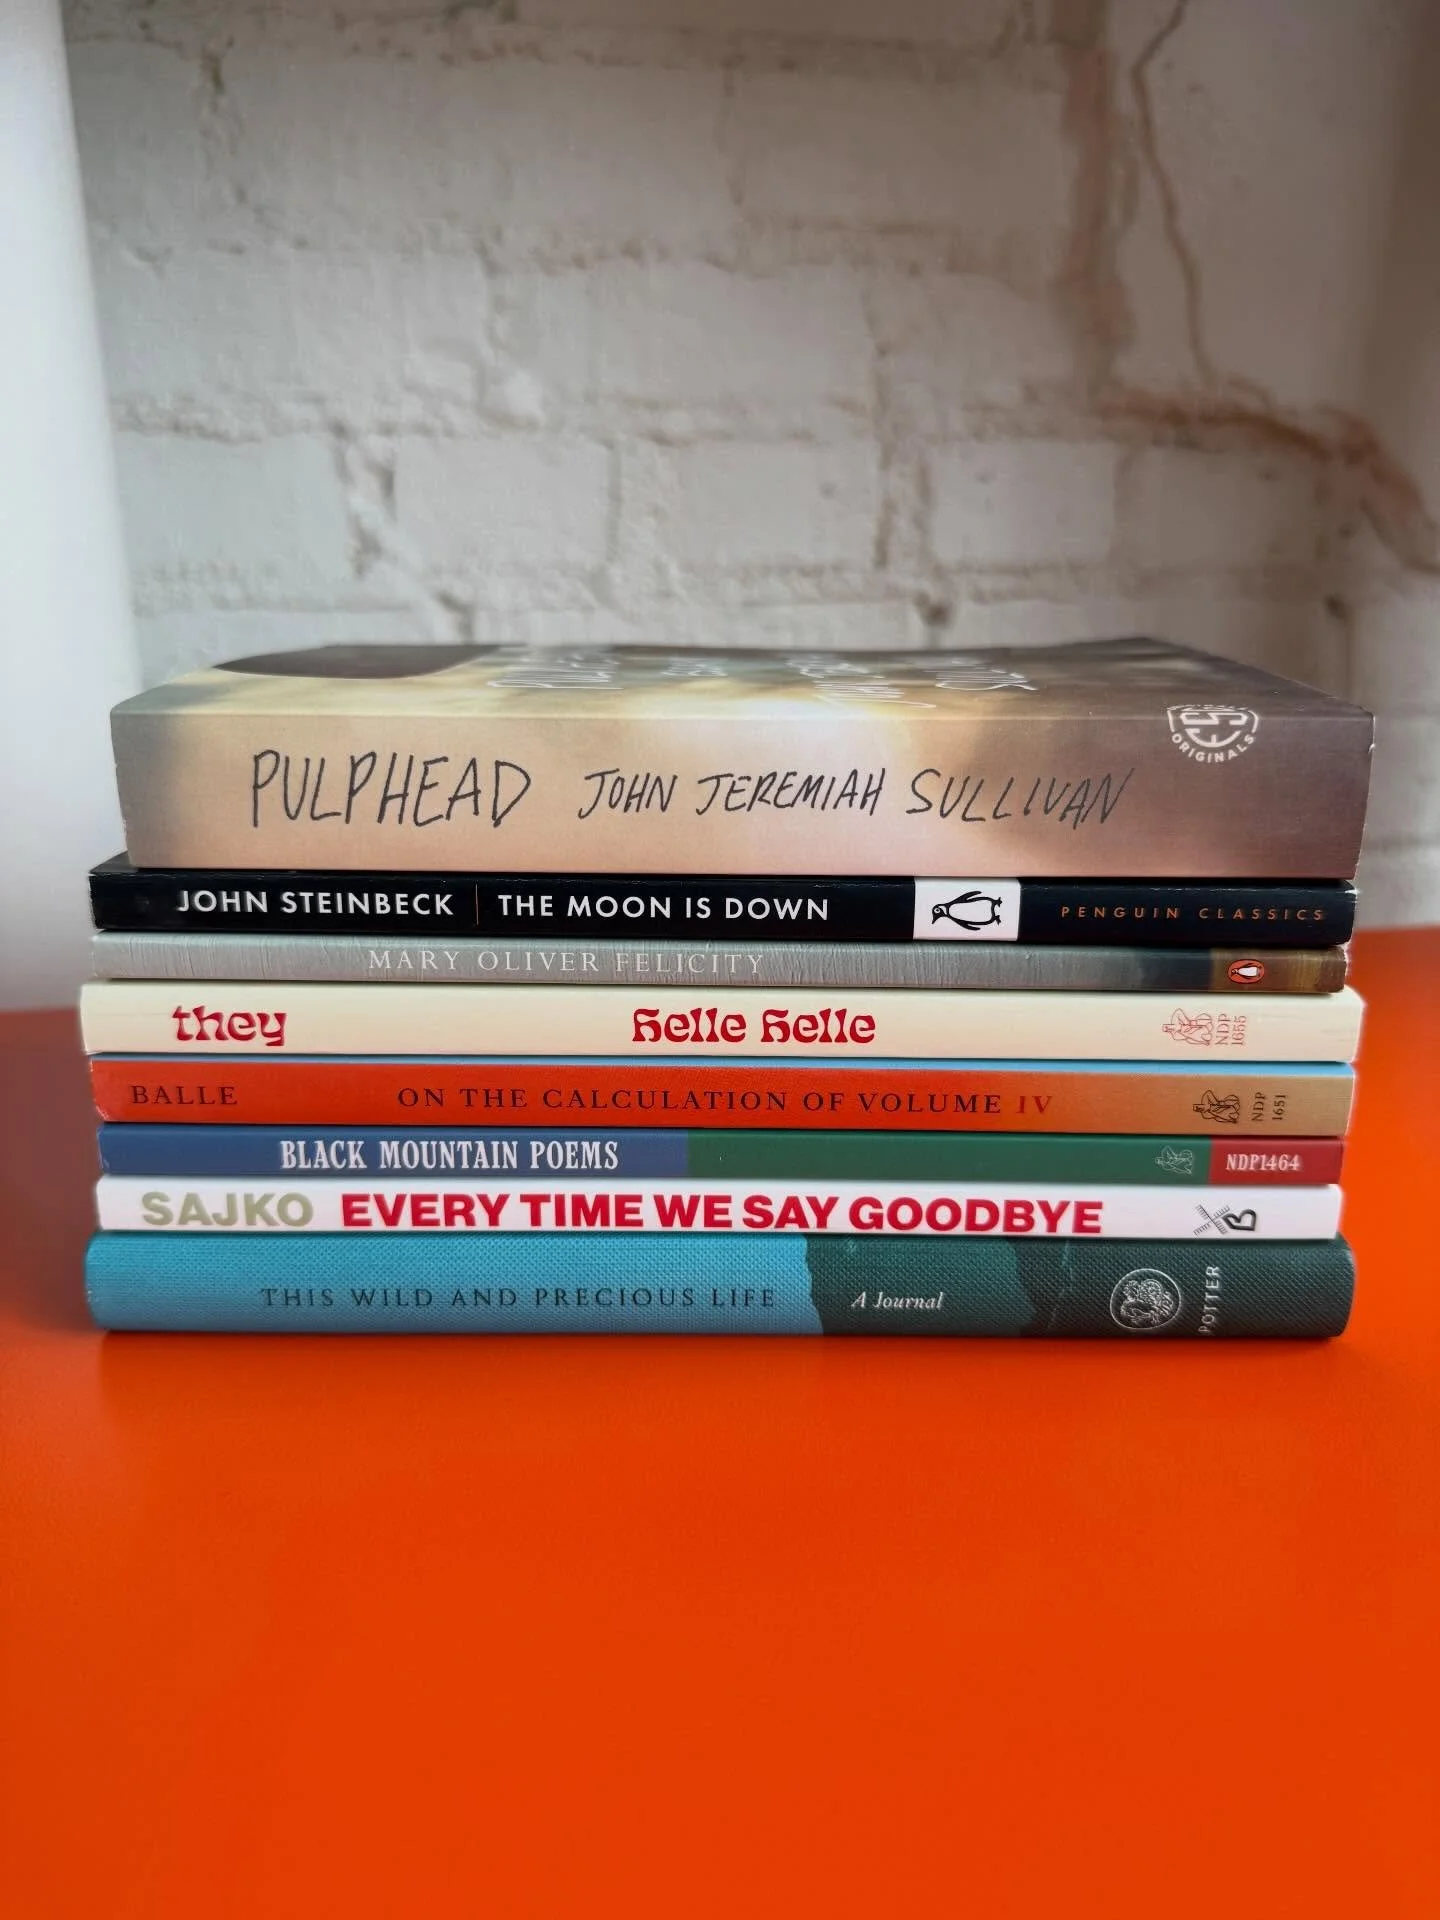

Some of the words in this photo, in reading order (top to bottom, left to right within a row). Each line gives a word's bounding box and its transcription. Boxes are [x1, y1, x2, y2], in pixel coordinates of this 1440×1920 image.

[1171, 733, 1255, 764] ORIGINALS
[252, 749, 531, 828] PULPHEAD
[577, 768, 679, 820] JOHN
[696, 767, 886, 817] JEREMIAH
[905, 767, 1136, 831] SULLIVAN
[177, 890, 269, 913] JOHN
[280, 891, 454, 916] STEINBECK
[497, 894, 554, 917] THE
[566, 895, 672, 919] MOON
[685, 897, 711, 919] IS
[725, 898, 829, 921] DOWN
[1061, 905, 1181, 920] PENGUIN
[1198, 906, 1325, 921] CLASSICS
[368, 950, 460, 970] MARY
[477, 951, 599, 972] OLIVER
[615, 952, 765, 974] FELICITY
[172, 1005, 287, 1046] they
[1215, 1013, 1231, 1046] NDP
[1231, 1015, 1247, 1046] 1655
[130, 1085, 237, 1105] BALLE
[397, 1087, 445, 1107] ON
[460, 1088, 528, 1108] THE
[542, 1089, 786, 1112] CALCULATION
[803, 1092, 845, 1112] OF
[857, 1093, 1001, 1113] VOLUME
[1016, 1095, 1053, 1114] IV
[1252, 1092, 1266, 1122] NDP
[1272, 1094, 1288, 1121] 1651
[279, 1140, 368, 1169] BLACK
[378, 1140, 519, 1169] MOUNTAIN
[529, 1140, 619, 1170] POEMS
[1225, 1153, 1302, 1171] NDP1464
[141, 1191, 314, 1227] SAJKO
[342, 1193, 510, 1227] EVERY
[519, 1194, 644, 1227] TIME
[653, 1194, 733, 1228] WE
[742, 1195, 840, 1230] SAY
[849, 1196, 1104, 1234] GOODBYE
[261, 1288, 336, 1307] THIS
[350, 1288, 434, 1307] WILD
[451, 1288, 518, 1307] AND
[534, 1288, 695, 1307] PRECIOUS
[711, 1288, 775, 1308] LIFE
[851, 1291, 867, 1309] A
[872, 1291, 944, 1310] Journal
[1198, 1265, 1222, 1333] POTTER
